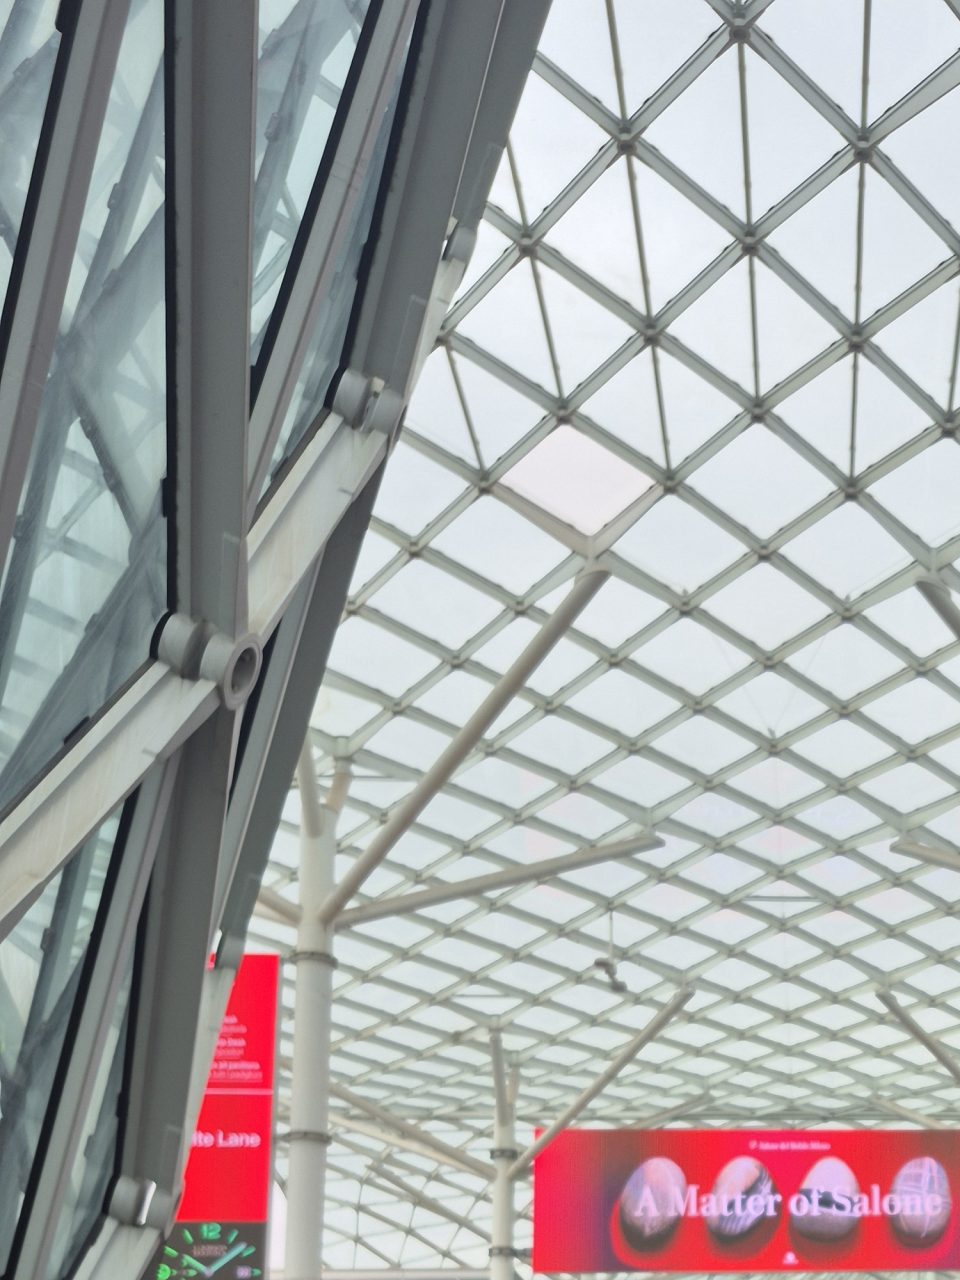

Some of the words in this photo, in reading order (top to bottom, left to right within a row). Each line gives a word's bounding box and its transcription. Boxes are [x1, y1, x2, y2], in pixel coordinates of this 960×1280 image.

[216, 1130, 262, 1149] Lane
[634, 1184, 661, 1218] A
[666, 1184, 783, 1218] Matter
[788, 1184, 826, 1218] of
[838, 1183, 943, 1218] Salone
[200, 1222, 222, 1240] 12
